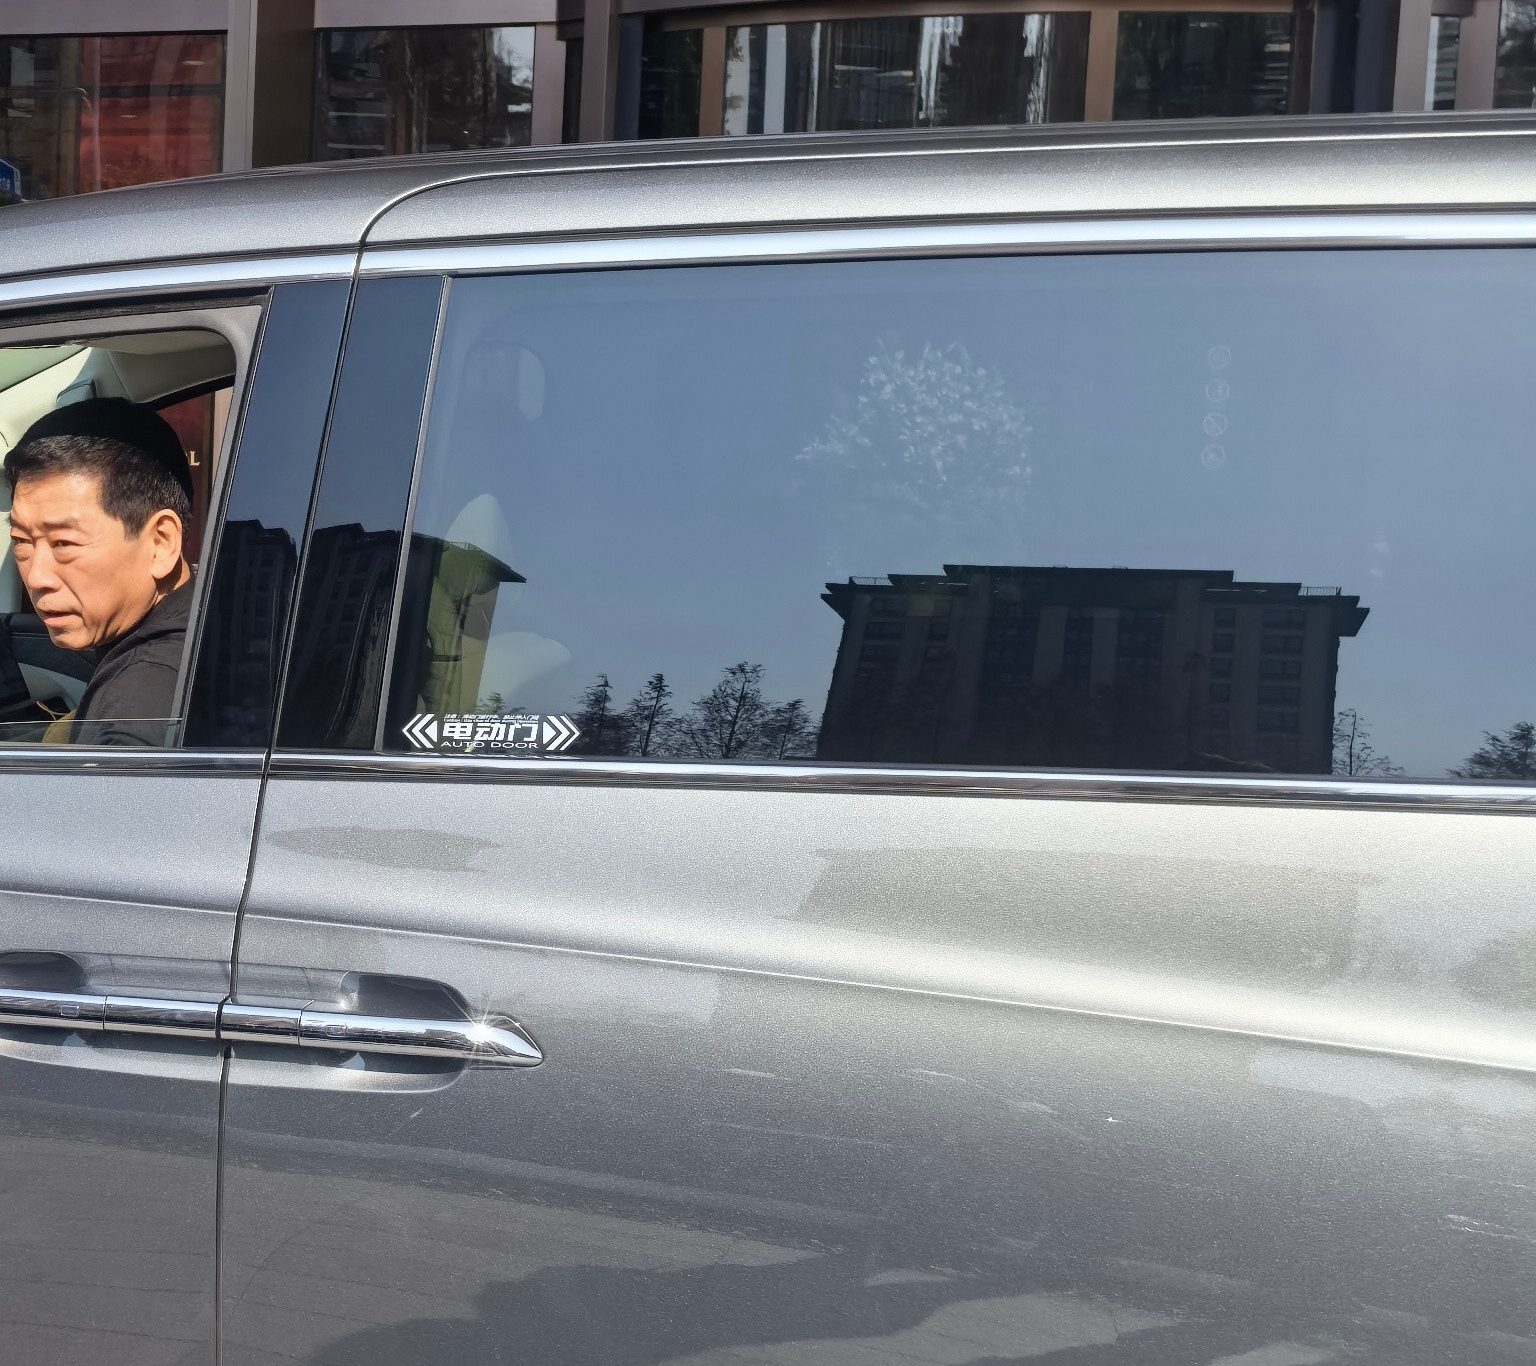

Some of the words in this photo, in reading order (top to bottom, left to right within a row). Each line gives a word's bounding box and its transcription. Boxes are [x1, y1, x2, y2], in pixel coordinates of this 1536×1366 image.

[442, 722, 539, 742] 电动门
[491, 741, 538, 749] DOOR
